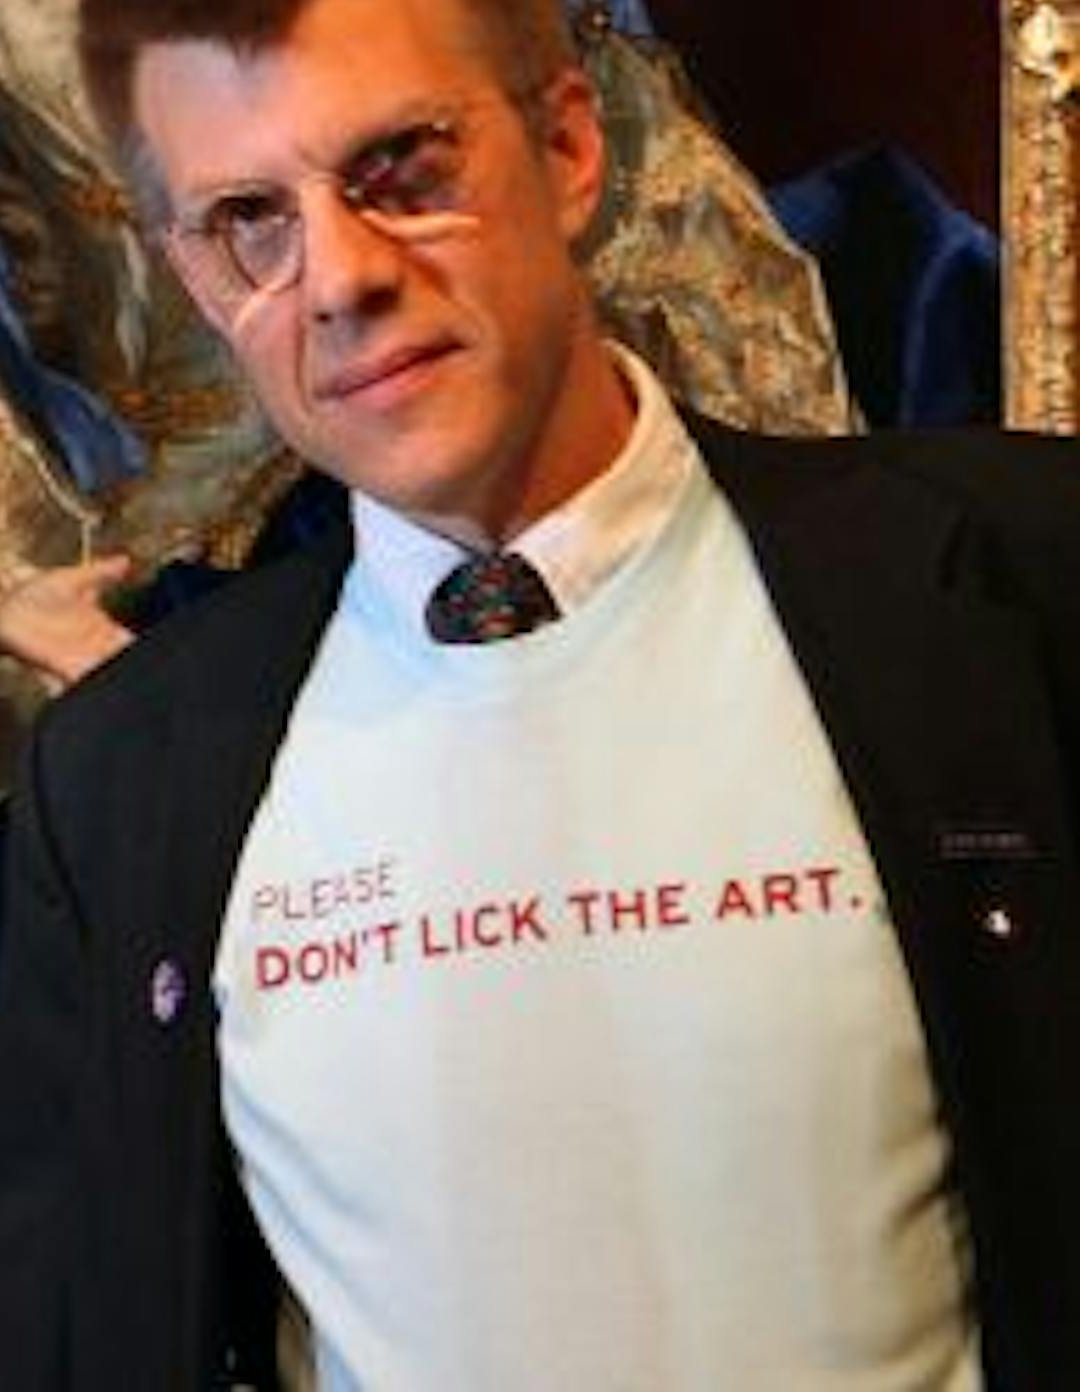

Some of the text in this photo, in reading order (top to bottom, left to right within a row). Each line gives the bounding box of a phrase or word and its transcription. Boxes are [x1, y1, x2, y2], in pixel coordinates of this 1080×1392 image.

[254, 860, 396, 920] PLEASE
[255, 867, 864, 990] DON'T LICK THE ART.
